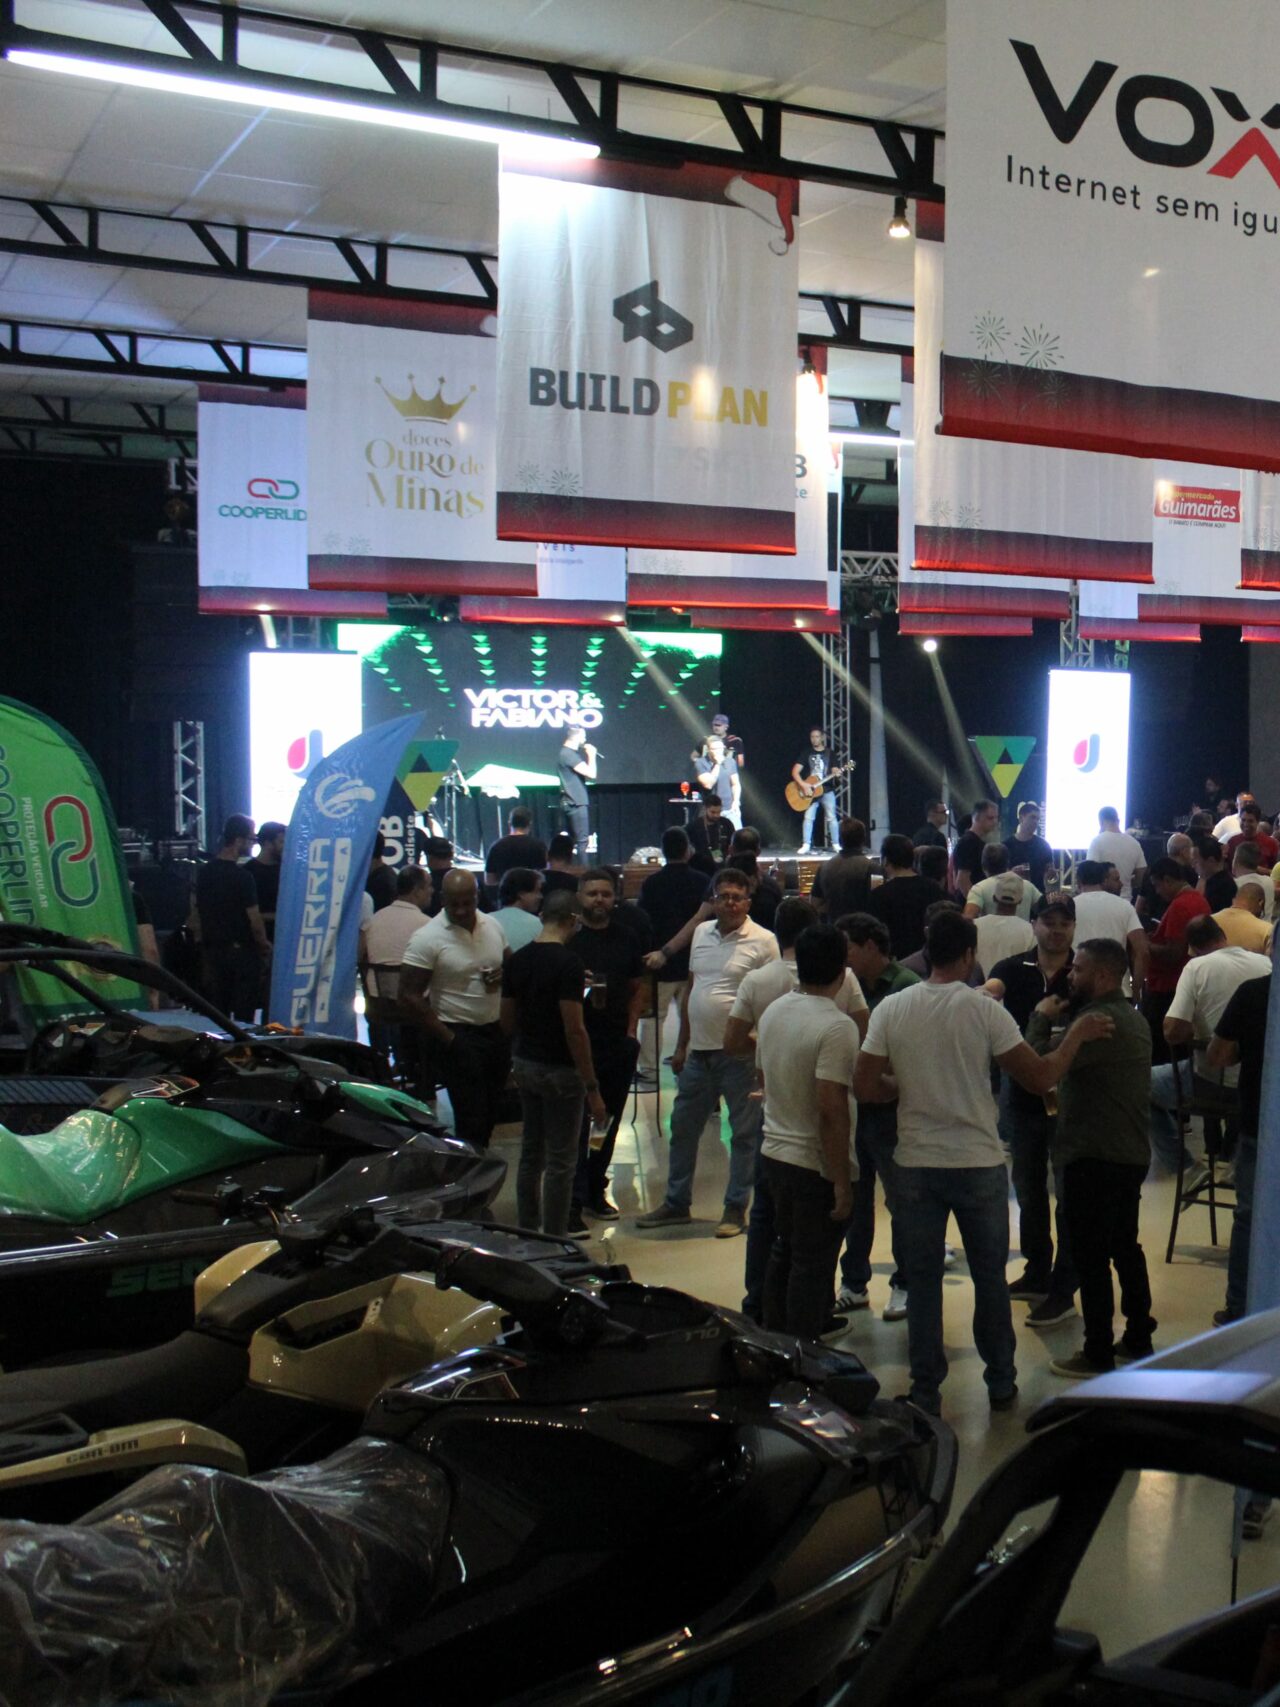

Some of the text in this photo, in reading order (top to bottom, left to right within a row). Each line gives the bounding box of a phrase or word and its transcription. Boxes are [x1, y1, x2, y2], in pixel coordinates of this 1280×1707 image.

[1006, 154, 1141, 210] Internet
[1156, 193, 1219, 222] sem
[402, 429, 452, 448] doces
[460, 455, 486, 476] de
[366, 471, 485, 520] Minas
[1160, 496, 1237, 519] Guimarães
[463, 688, 605, 710] VICTOR &
[471, 708, 604, 729] FABIANO
[290, 837, 331, 1027] GUERRA
